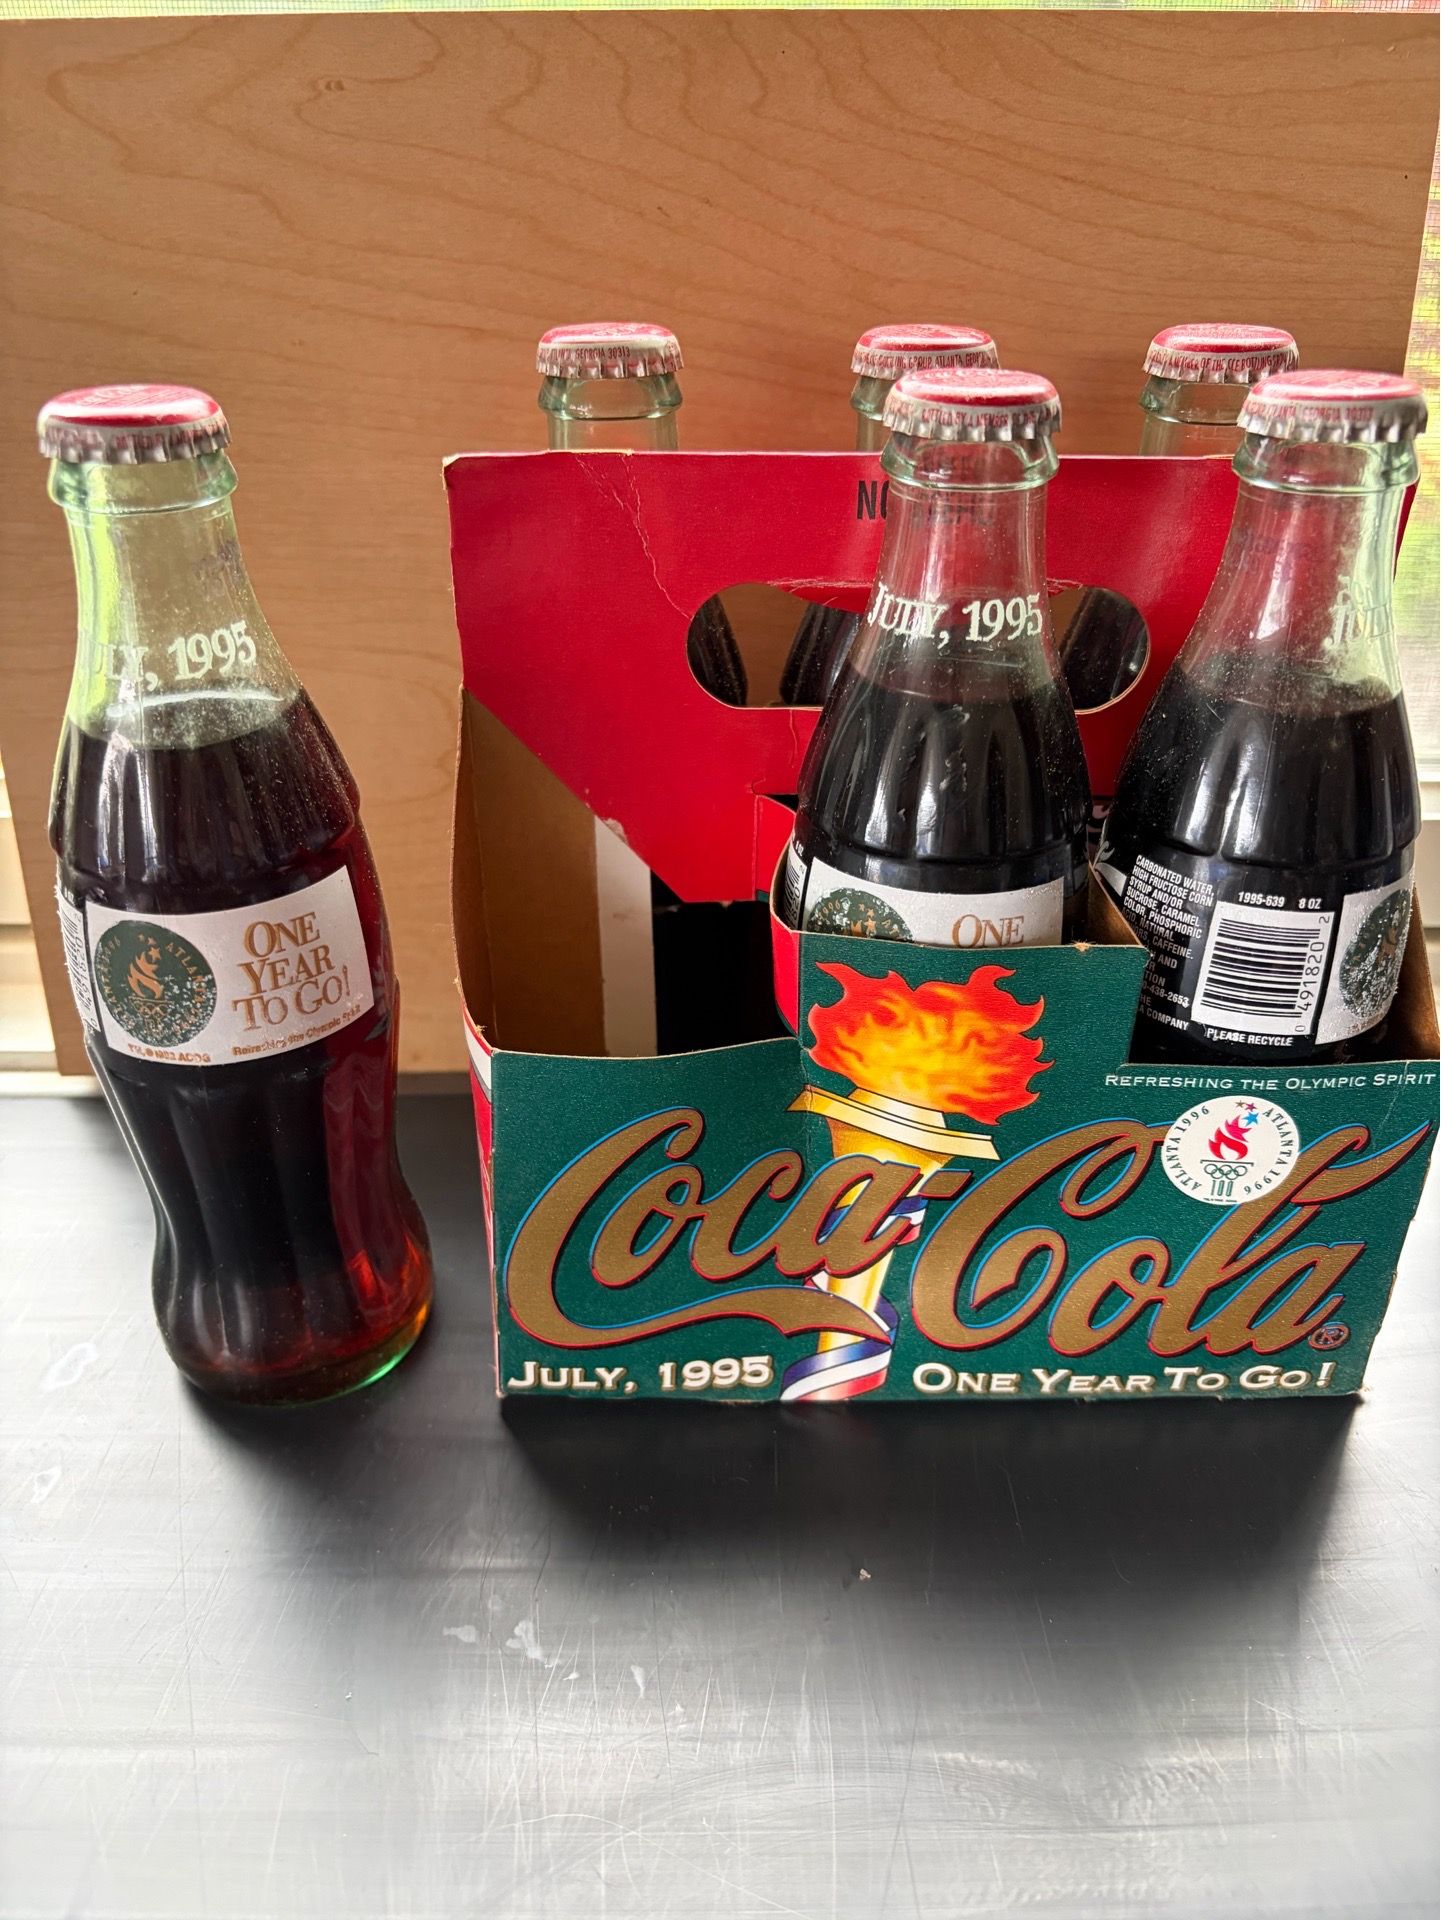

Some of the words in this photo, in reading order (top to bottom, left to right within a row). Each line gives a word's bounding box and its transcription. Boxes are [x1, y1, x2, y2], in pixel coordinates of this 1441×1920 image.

[608, 346, 631, 360] 30313
[1200, 357, 1212, 370] OF
[867, 581, 950, 650] JULY,
[962, 592, 1043, 642] 1995
[168, 619, 257, 681] 1995
[1132, 865, 1149, 882] HIGH
[1148, 873, 1188, 900] FRUCTOSE
[1189, 891, 1214, 907] CORN
[1135, 854, 1182, 885] CARBONATED
[1183, 875, 1215, 896] WATER,
[1126, 886, 1158, 912] SUCROSE,
[1160, 904, 1200, 928] CARAMEL
[1129, 876, 1152, 893] SYRUP
[1151, 890, 1184, 910] AND/OR
[1237, 890, 1286, 908] 1995-639
[1298, 898, 1306, 910] 8
[1308, 898, 1322, 910] OZ
[243, 911, 321, 958] ONE
[952, 914, 1025, 948] ONE
[1123, 896, 1147, 918] COLOR,
[1149, 910, 1203, 939] PHOSPHORIC
[1139, 917, 1174, 941] NATURAL
[1151, 935, 1194, 960] CAFFEINE.
[1157, 953, 1178, 970] AND
[236, 943, 336, 997] YEAR
[1297, 941, 1326, 1012] 491820
[231, 993, 289, 1031] TO
[294, 963, 351, 1015] GO!
[1146, 1007, 1190, 1031] COMPANY
[1206, 1027, 1246, 1044] PLEASE
[1247, 1034, 1294, 1047] RECYCLE
[1104, 1073, 1233, 1090] REFRESHING
[1240, 1078, 1278, 1091] THE
[1285, 1075, 1366, 1091] OLYMPIC
[1373, 1072, 1437, 1088] SPIRIT
[1175, 1105, 1210, 1133] 1996
[1262, 1107, 1294, 1166] ATLANTA
[1166, 1136, 1202, 1191] ATLANTA
[1243, 1169, 1281, 1195] 1996
[507, 1361, 638, 1396] JULY,
[658, 1354, 775, 1391] 1995
[912, 1361, 1021, 1395] ONE
[1031, 1366, 1156, 1395] YEAR
[1162, 1364, 1231, 1393] TO
[1238, 1361, 1338, 1391] GO!
